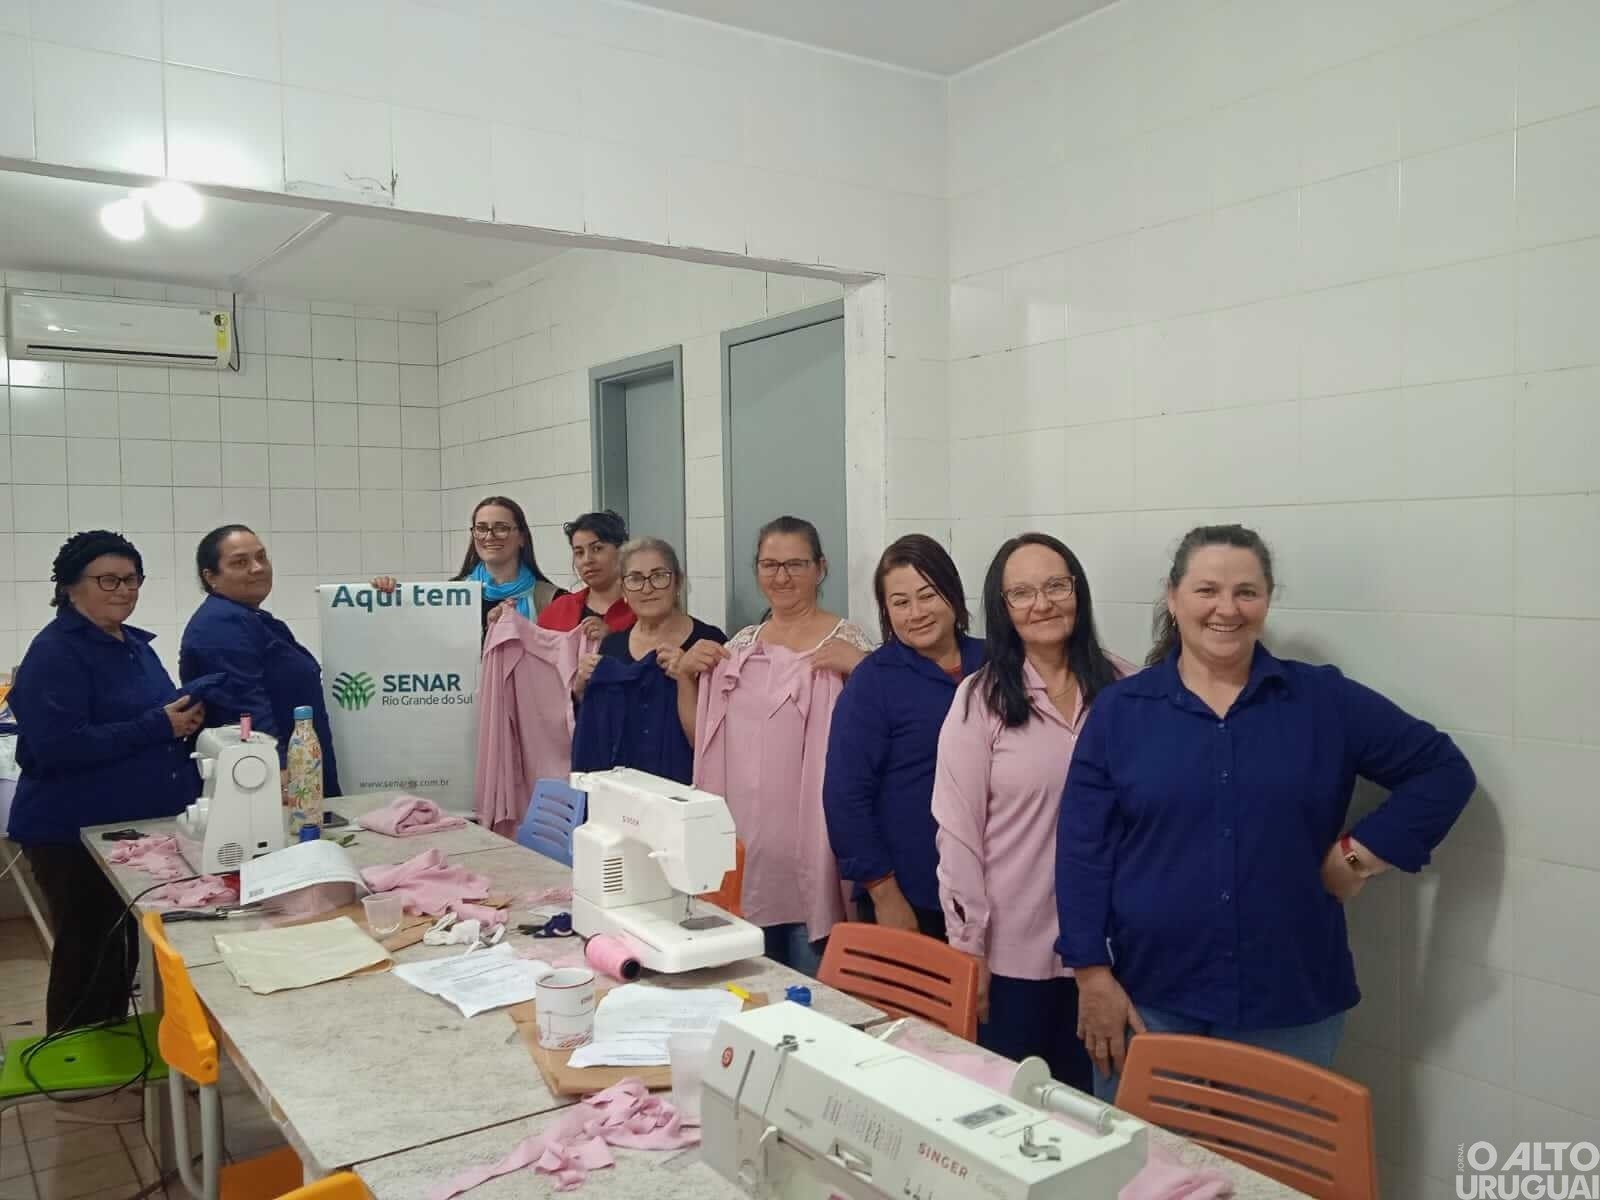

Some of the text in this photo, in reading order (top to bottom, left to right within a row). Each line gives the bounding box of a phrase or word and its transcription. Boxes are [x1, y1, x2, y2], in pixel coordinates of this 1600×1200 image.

[331, 583, 471, 613] Aqui tem
[382, 673, 461, 693] SENAR
[382, 694, 473, 706] Rio Grande do Sul
[918, 1141, 969, 1180] SINGER
